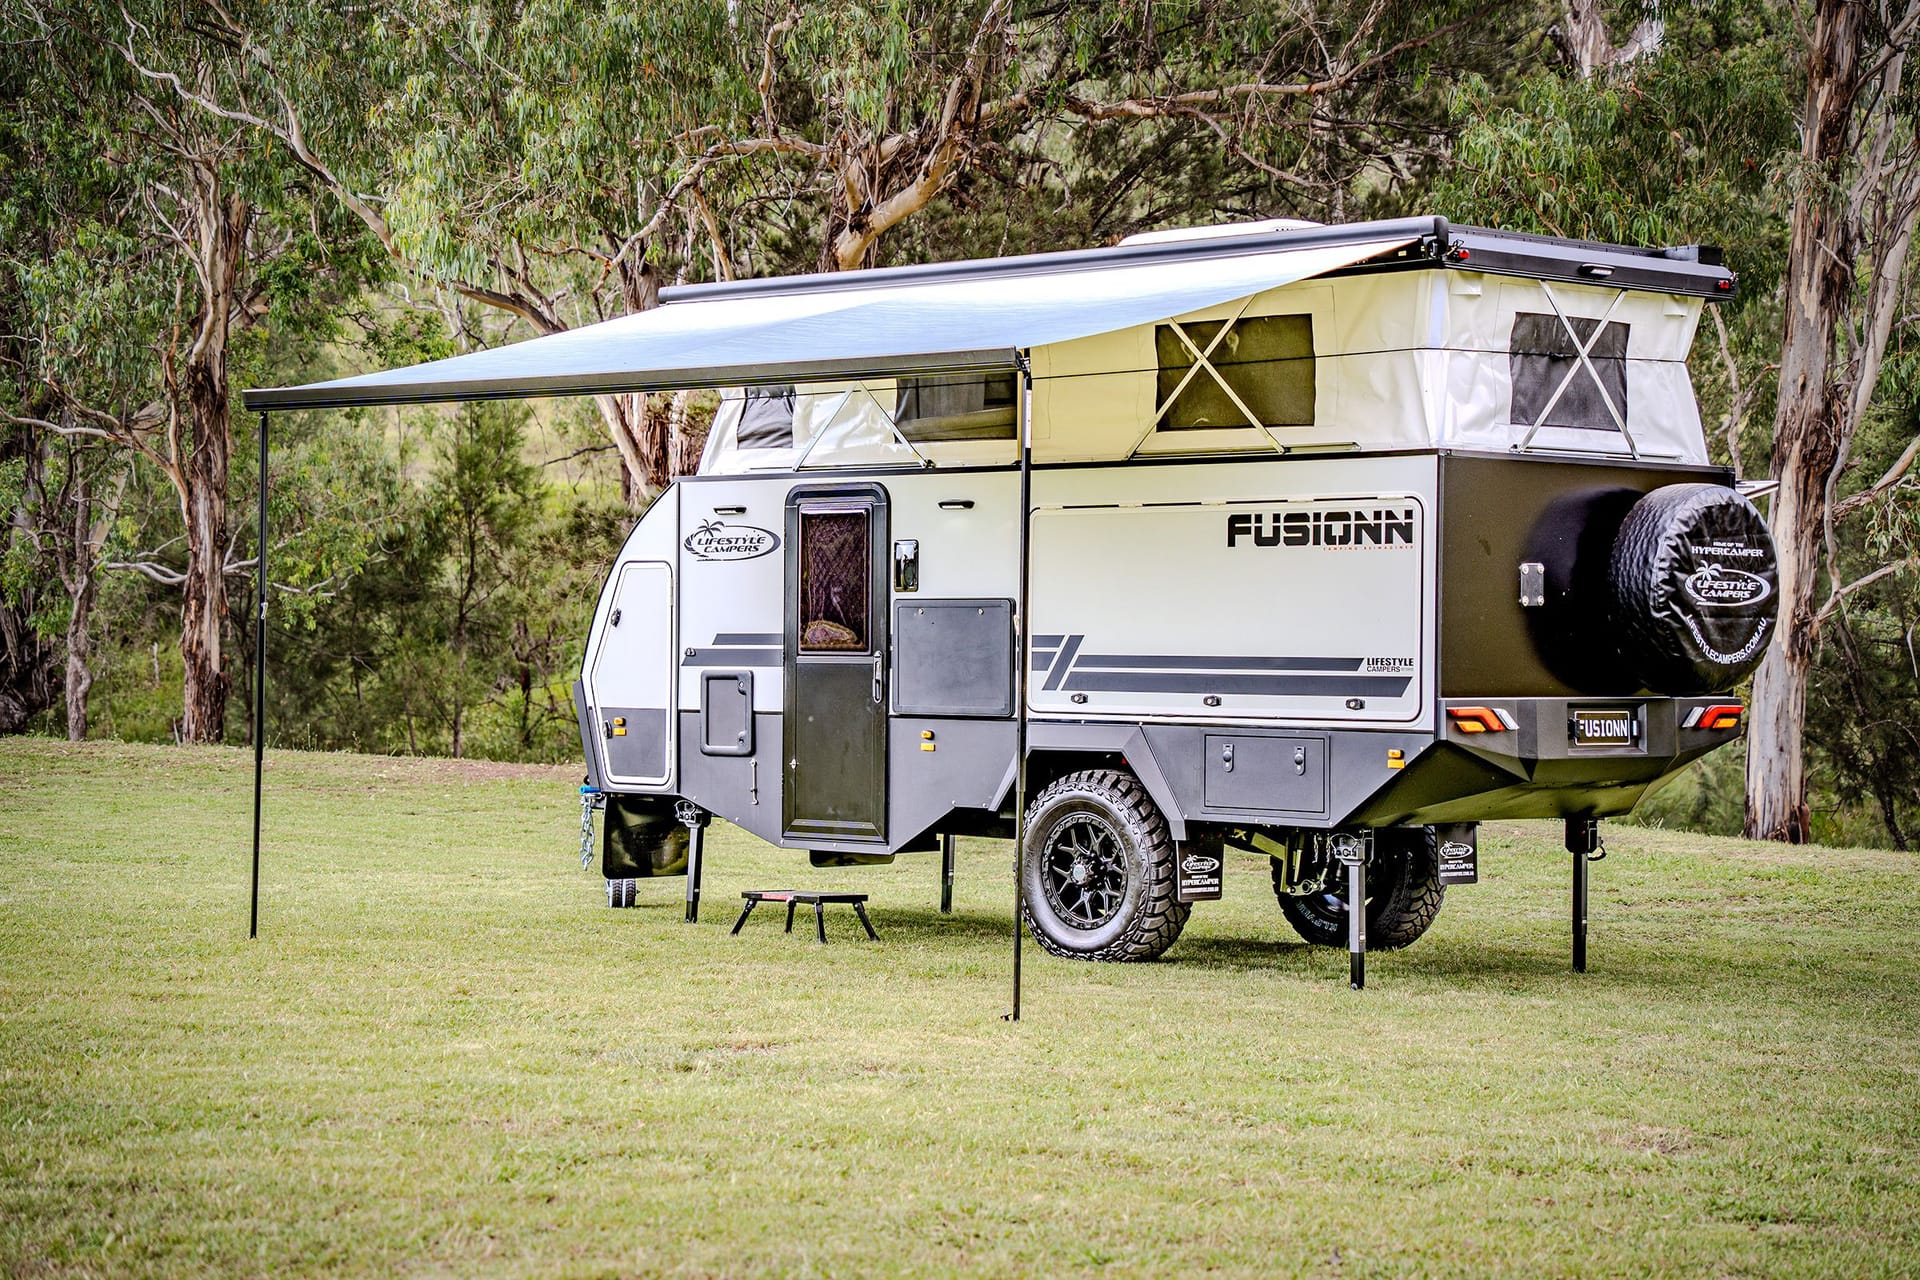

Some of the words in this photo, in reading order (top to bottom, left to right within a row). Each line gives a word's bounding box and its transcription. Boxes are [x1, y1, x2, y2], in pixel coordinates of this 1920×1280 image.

[1227, 509, 1414, 547] FUSIONN
[697, 537, 766, 545] LIFESTYLE
[704, 545, 760, 553] CAMPERS
[1691, 546, 1764, 557] HYPERCAMPER
[1697, 580, 1758, 591] LIFESTYLE
[1701, 589, 1752, 599] CAMPERS
[1686, 614, 1768, 665] LIFESTYLECAMPERS.COM.AU
[1366, 657, 1414, 666] LIFESTYLE
